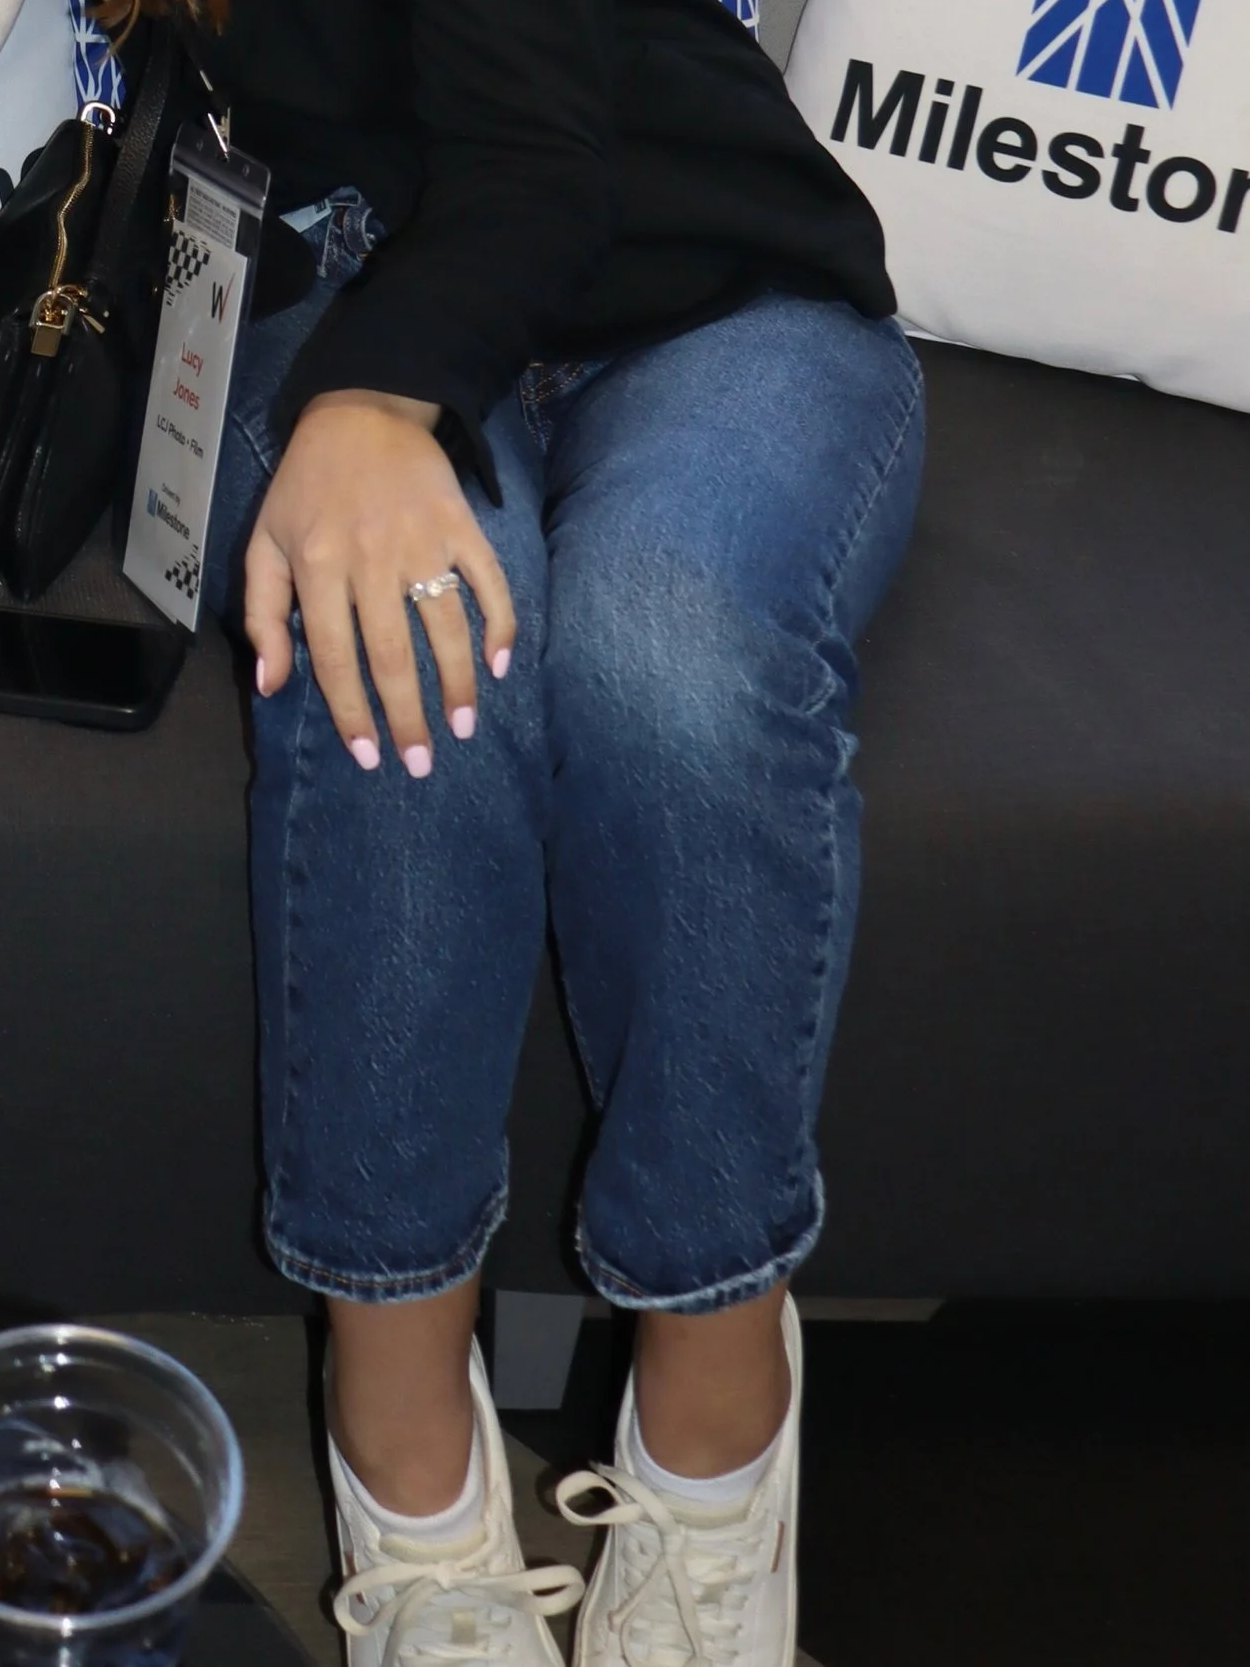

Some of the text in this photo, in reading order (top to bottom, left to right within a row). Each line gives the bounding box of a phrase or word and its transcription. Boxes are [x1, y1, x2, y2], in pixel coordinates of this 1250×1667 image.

[181, 341, 204, 377] Lucy
[173, 378, 200, 410] Jones
[156, 499, 190, 540] Milestone
